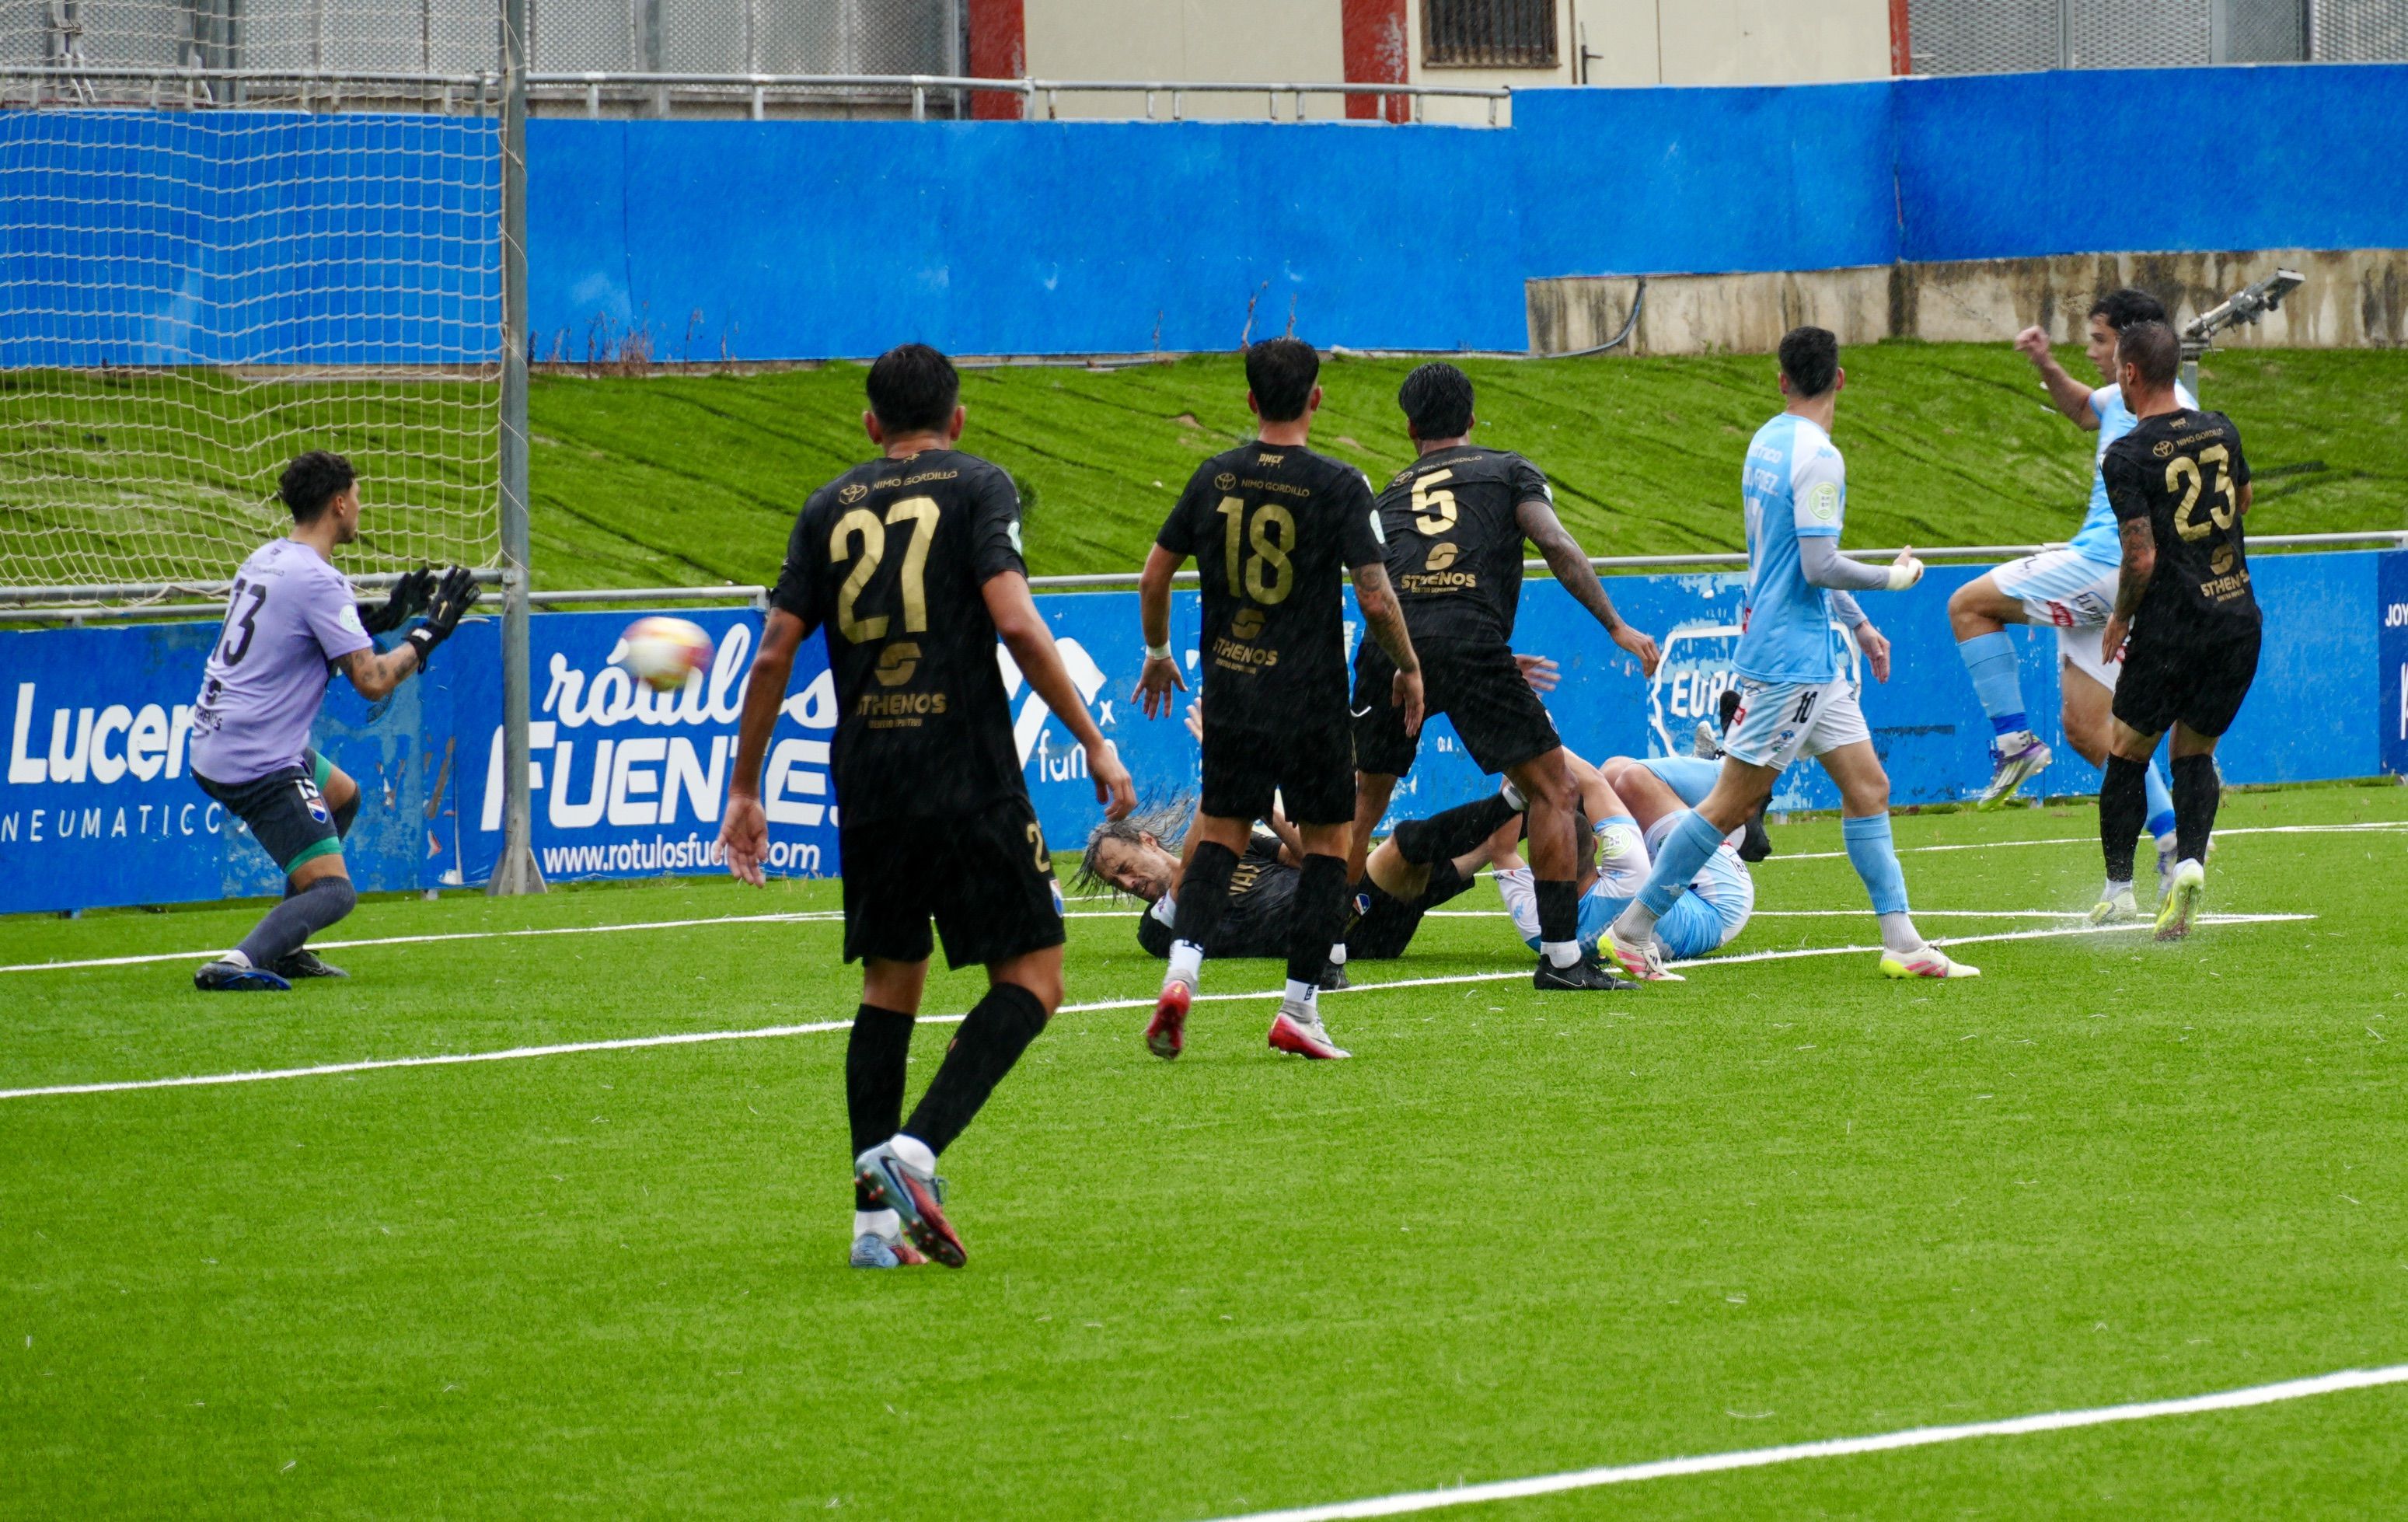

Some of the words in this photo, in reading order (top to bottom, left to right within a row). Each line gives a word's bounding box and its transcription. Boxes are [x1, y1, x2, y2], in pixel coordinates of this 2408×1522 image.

[872, 478, 902, 491] NIMO
[904, 470, 958, 486] GORDILLO
[1241, 478, 1264, 489] NIMO
[1265, 482, 1310, 497] GORDILLO
[1410, 469, 1458, 536] 5
[2165, 443, 2236, 543] 23
[829, 495, 941, 644] 27
[1216, 496, 1296, 605] 18
[2200, 568, 2250, 597] STHENS
[211, 578, 266, 667] 13
[543, 623, 838, 729] róuls
[1792, 691, 1818, 723] 10
[295, 778, 319, 800] 13
[480, 721, 841, 832] FUENE
[1, 801, 247, 843] NEUMATICO
[543, 832, 821, 873] www.rotulosfueom
[1027, 823, 1050, 872] 2
